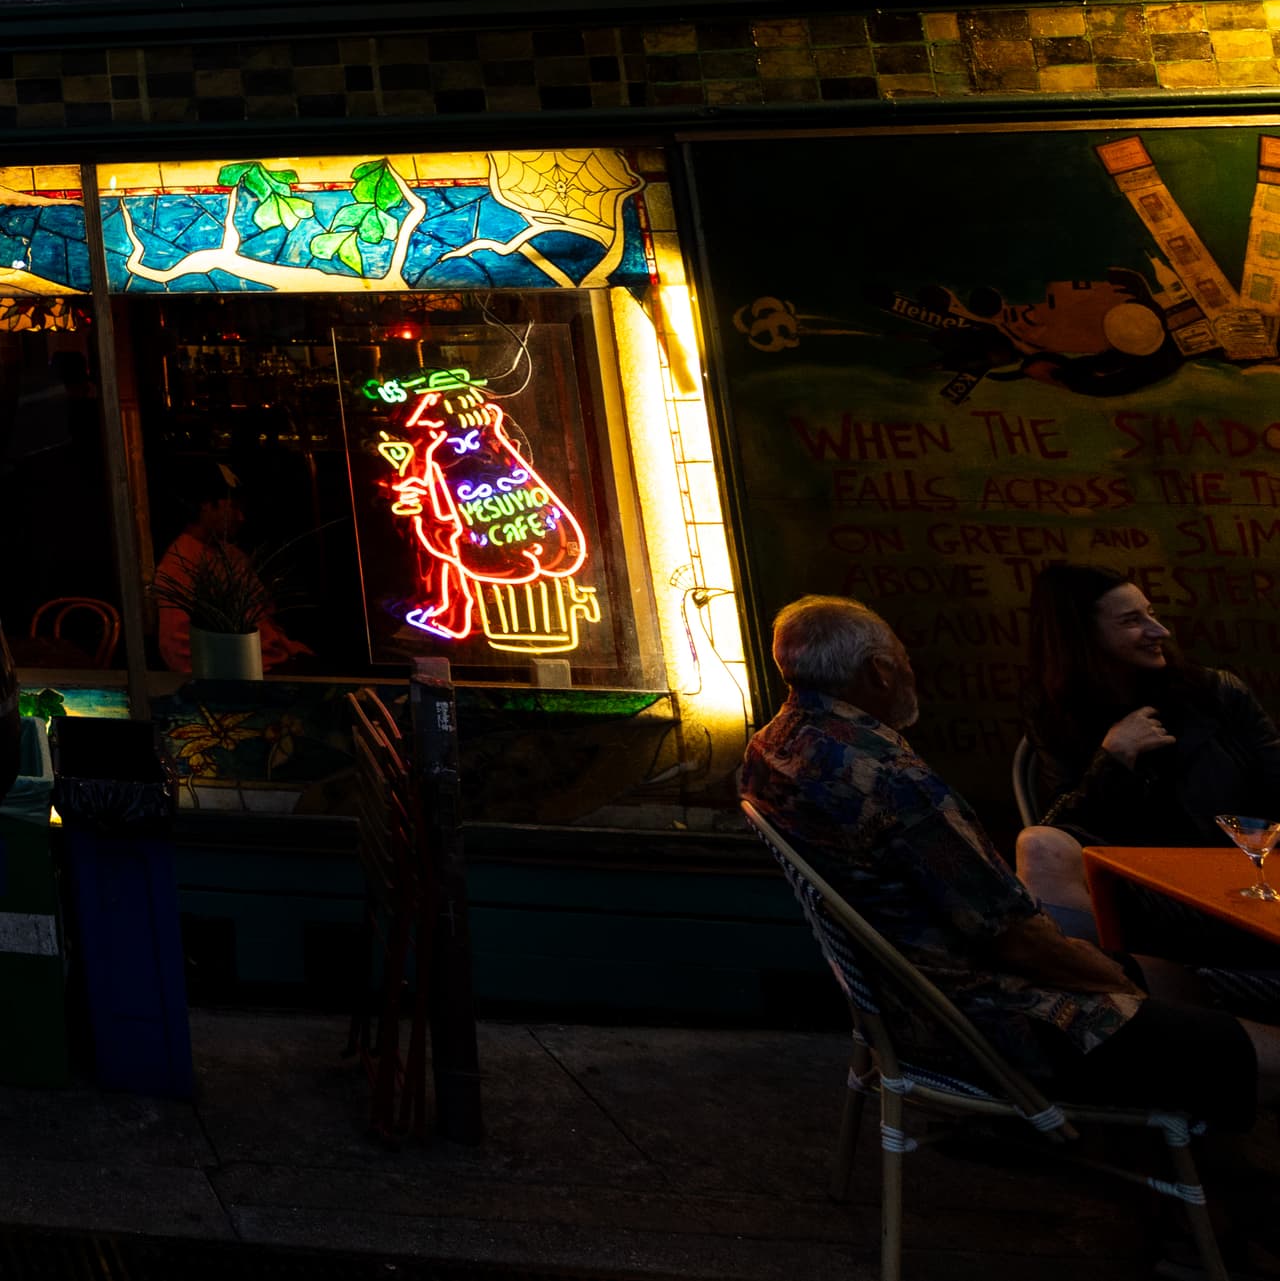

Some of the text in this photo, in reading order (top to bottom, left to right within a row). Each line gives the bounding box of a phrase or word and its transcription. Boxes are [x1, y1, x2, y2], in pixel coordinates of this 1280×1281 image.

[790, 413, 952, 460] WHEN
[971, 410, 1068, 460] THE
[458, 486, 550, 526] VESUVIO
[833, 469, 959, 512] FALLS
[982, 475, 1134, 512] ACROSS
[1153, 469, 1232, 506] THE
[488, 512, 547, 547] CAFE
[829, 526, 906, 555] ON
[928, 523, 1068, 556] GREEN
[1090, 526, 1149, 550] AND
[842, 562, 988, 598] ABOVE
[896, 610, 1043, 650] GAUN
